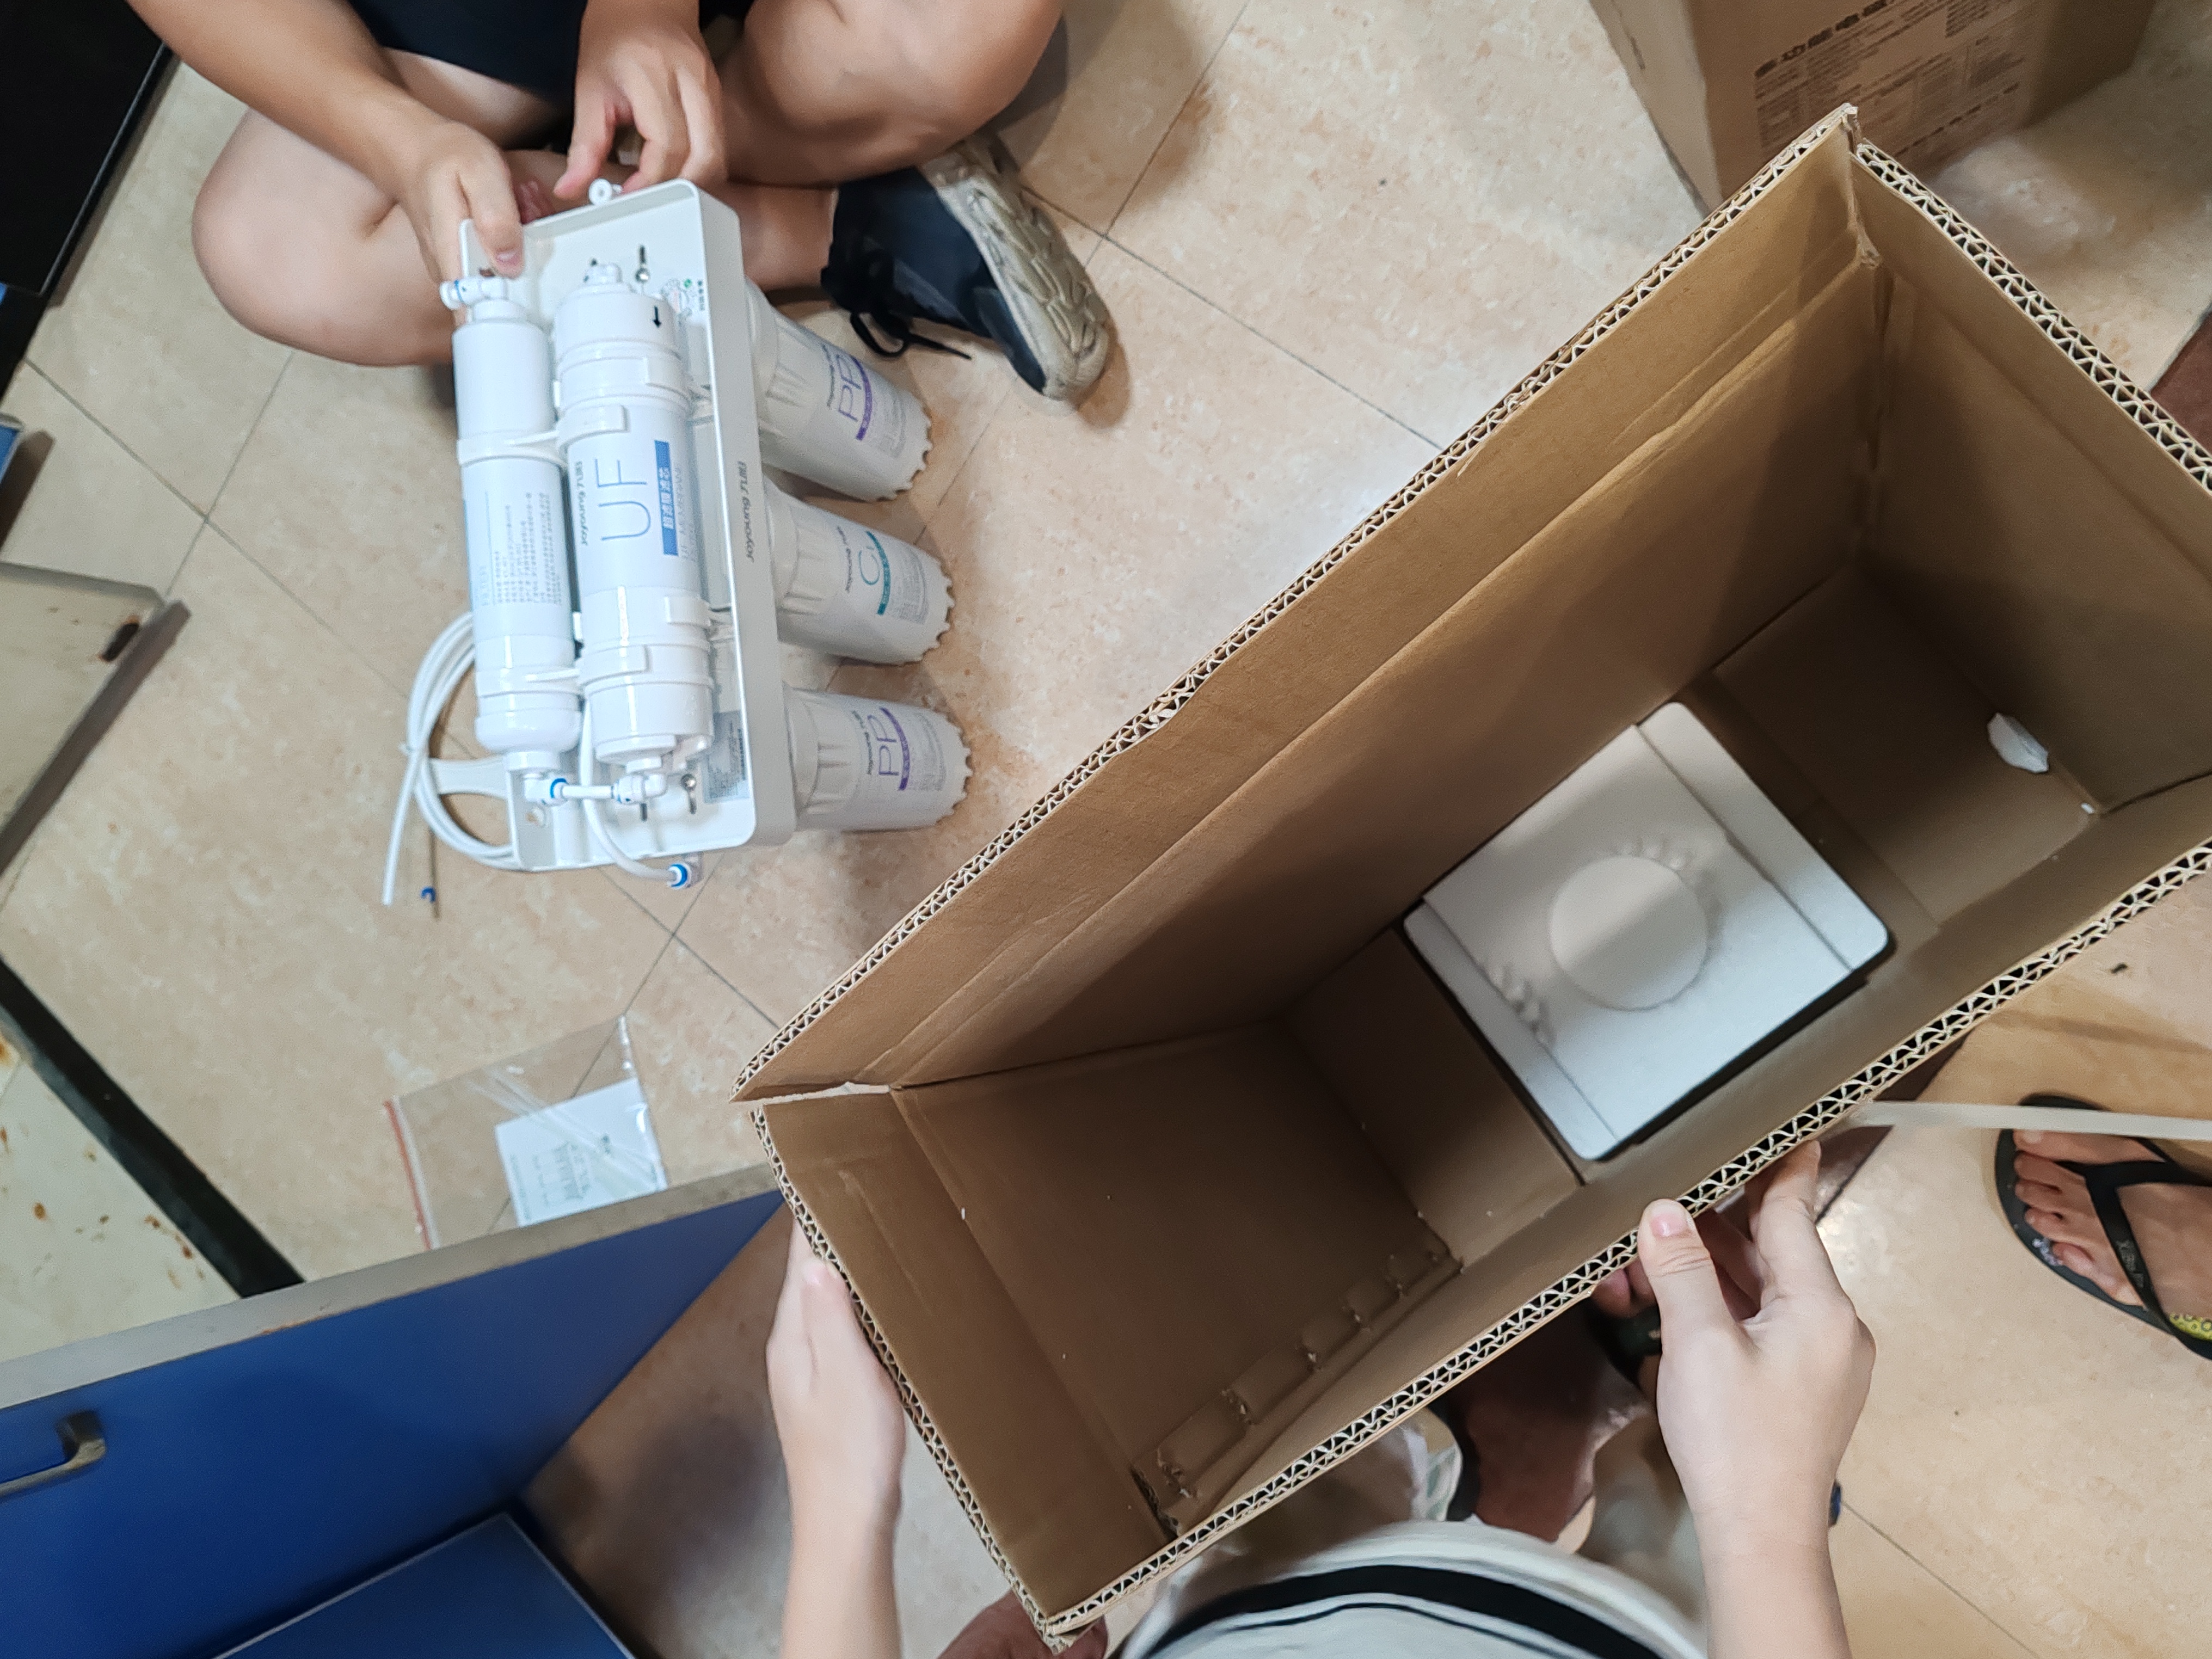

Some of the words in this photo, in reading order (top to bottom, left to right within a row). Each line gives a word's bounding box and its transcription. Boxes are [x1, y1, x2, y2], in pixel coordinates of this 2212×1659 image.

[836, 354, 862, 422] PP
[595, 458, 652, 541] UF
[867, 714, 900, 776] PP
